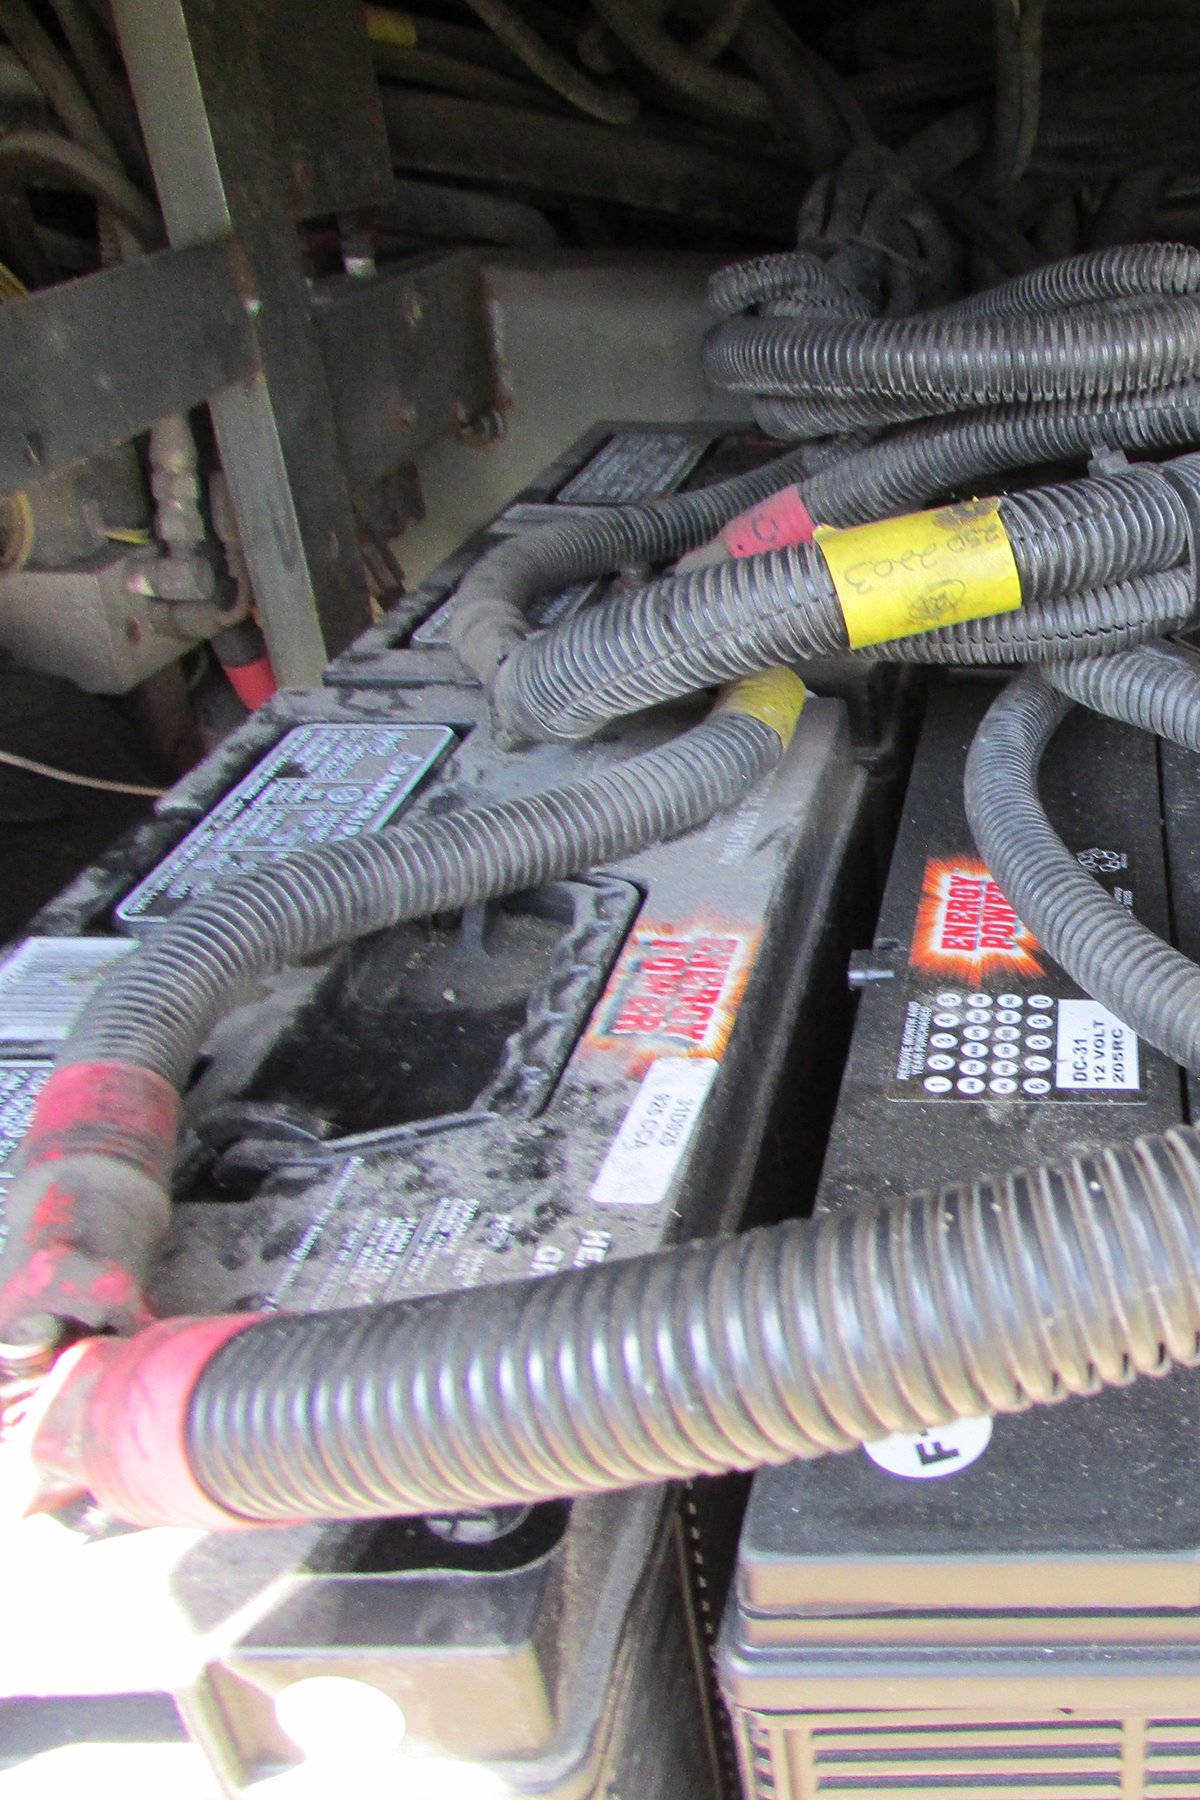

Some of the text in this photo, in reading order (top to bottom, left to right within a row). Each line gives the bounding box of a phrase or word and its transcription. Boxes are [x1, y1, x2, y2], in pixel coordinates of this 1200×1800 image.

[942, 875, 982, 951] ENERGY
[662, 938, 740, 1041] ENERGY
[1073, 1037, 1088, 1083] DC-31
[1093, 1019, 1107, 1083] 12 VOLT
[1111, 1028, 1126, 1084] 205RC
